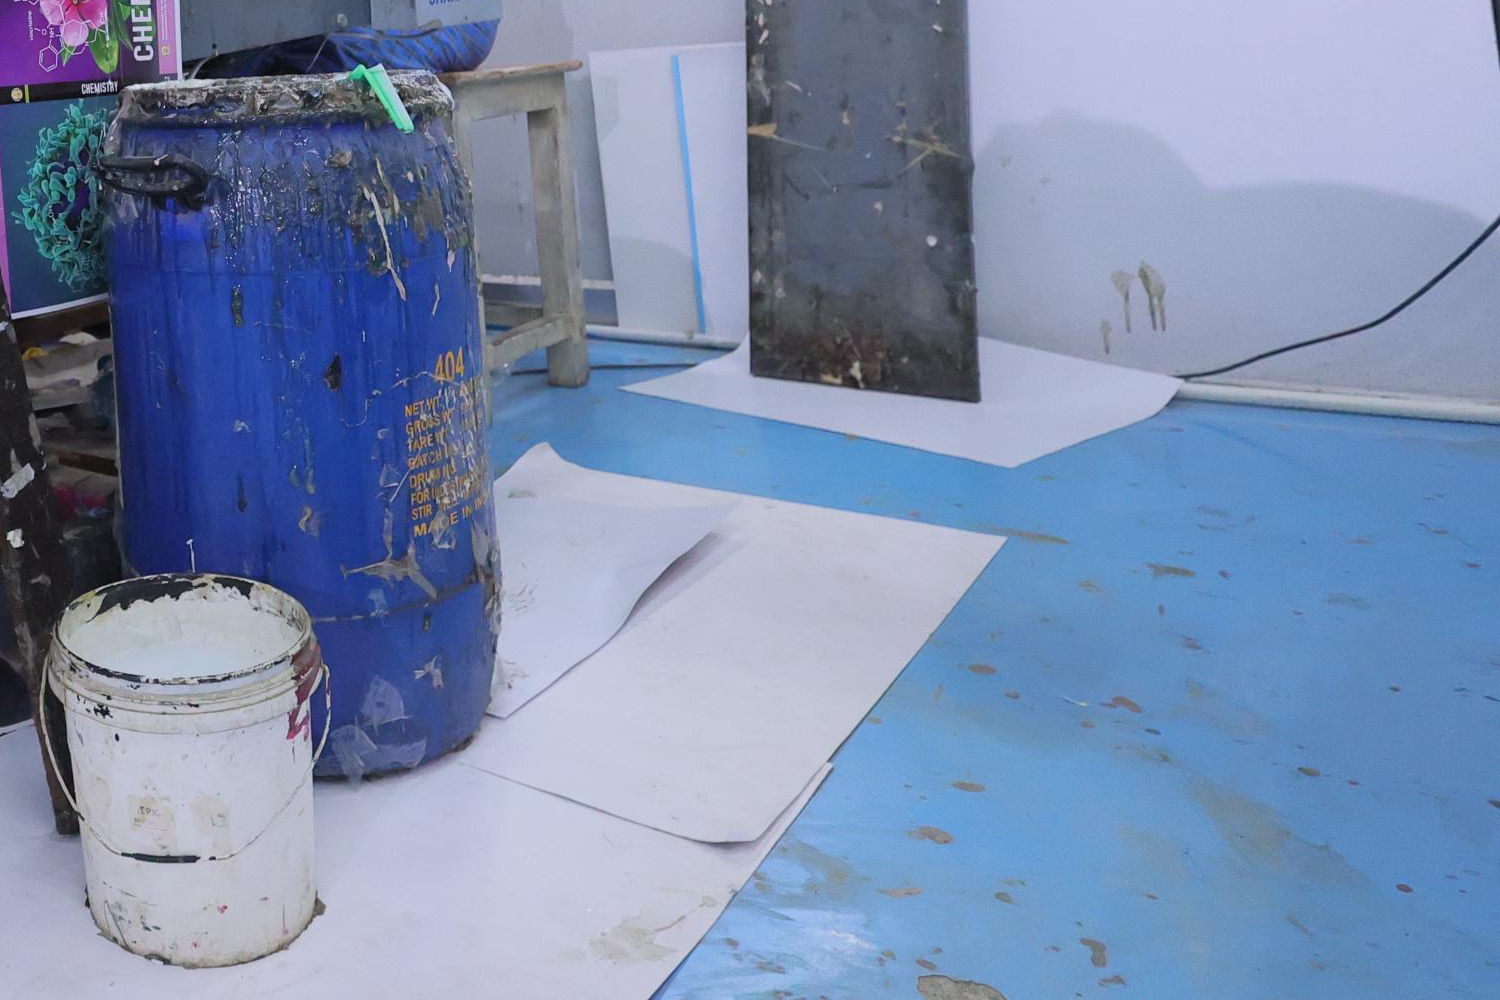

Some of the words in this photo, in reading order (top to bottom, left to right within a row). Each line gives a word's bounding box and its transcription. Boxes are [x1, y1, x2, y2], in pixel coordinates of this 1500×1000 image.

[81, 81, 118, 95] CHEMISTRY
[436, 347, 464, 381] 404
[404, 401, 424, 418] NET
[405, 418, 440, 434] GROSS
[408, 434, 433, 452] TARE
[408, 450, 442, 470] BATCH
[410, 467, 440, 488] DRUM
[411, 488, 429, 505] FOR
[412, 504, 432, 520] STIR
[462, 506, 472, 519] IN
